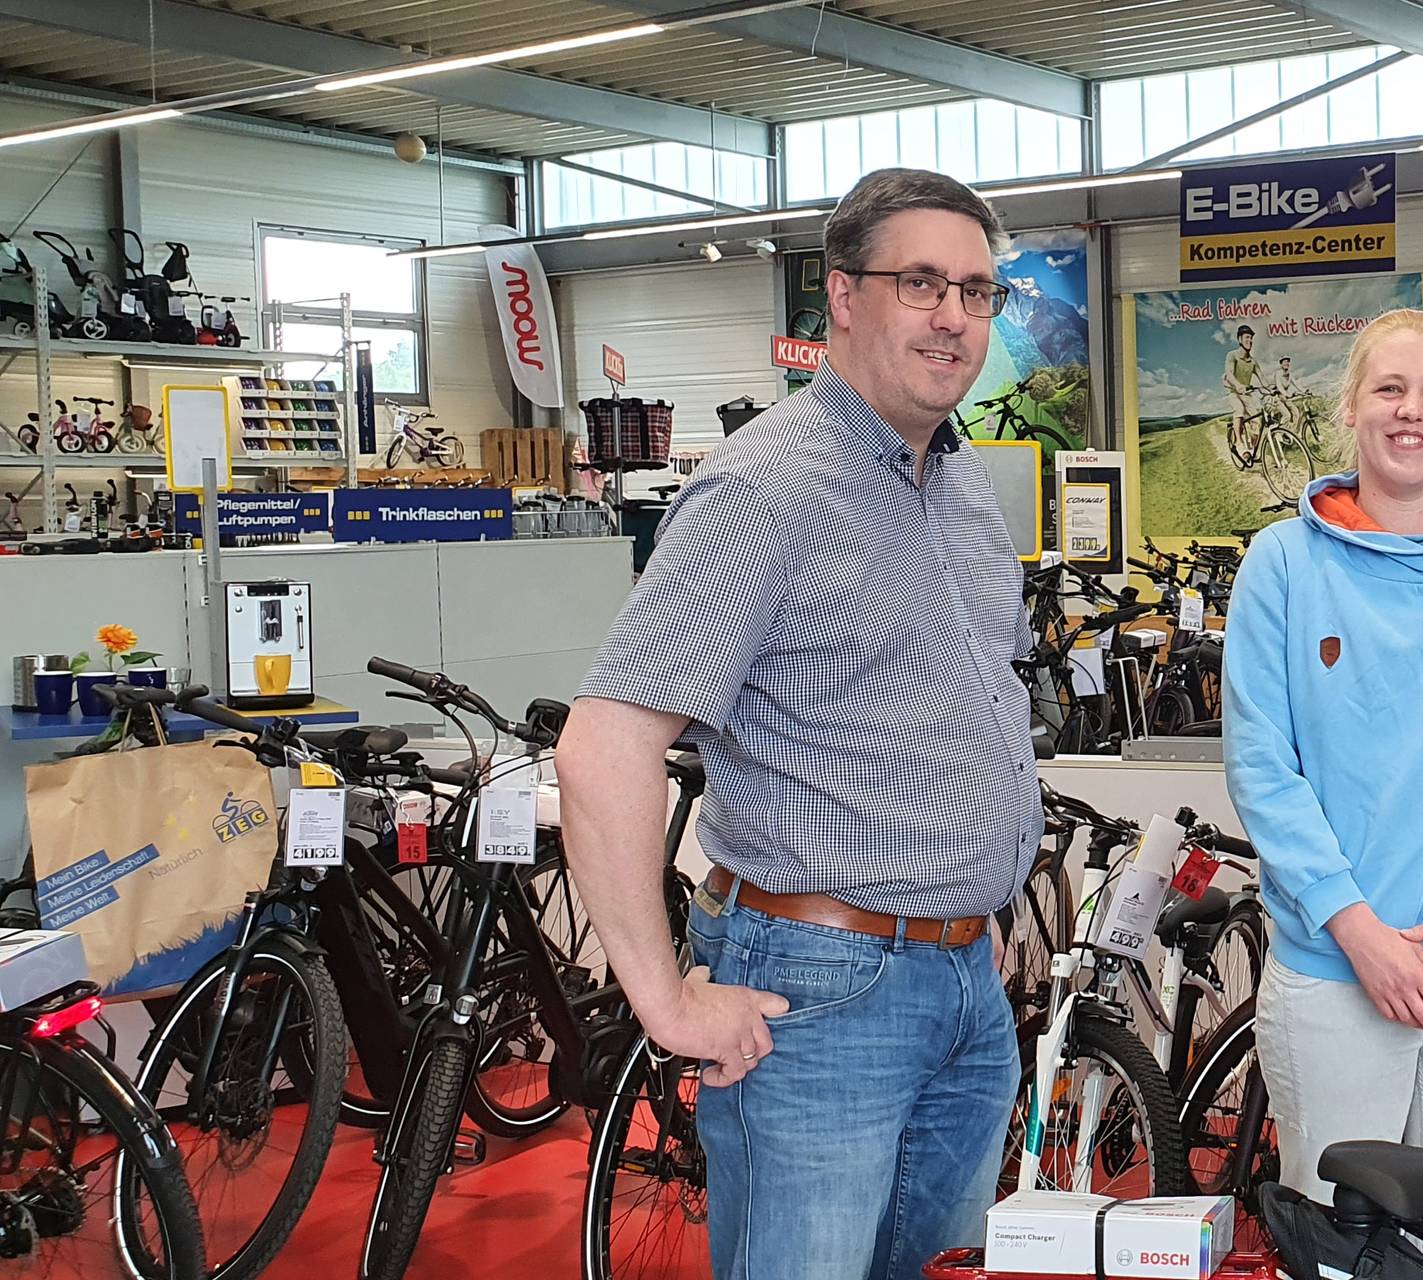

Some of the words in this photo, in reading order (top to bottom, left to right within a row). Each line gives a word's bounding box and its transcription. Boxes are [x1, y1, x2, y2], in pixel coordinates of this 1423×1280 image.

[1186, 182, 1319, 221] E-Bike
[1190, 235, 1386, 263] Kompetenz-Center
[1217, 299, 1272, 319] fahren
[1268, 320, 1298, 336] mit
[1305, 312, 1384, 334] Rücken
[1075, 455, 1099, 463] BOSCH
[378, 506, 481, 521] Trinkflaschen
[217, 810, 268, 843] ZEG
[405, 845, 421, 859] 15
[45, 868, 76, 889] Mein
[1180, 874, 1199, 893] 16
[47, 886, 83, 909] Meine
[50, 903, 90, 929] Meine
[798, 968, 841, 981] LEGEND
[994, 1232, 1026, 1240] Compact
[1027, 1233, 1056, 1243] Charger
[1140, 1251, 1190, 1267] BOSCH
